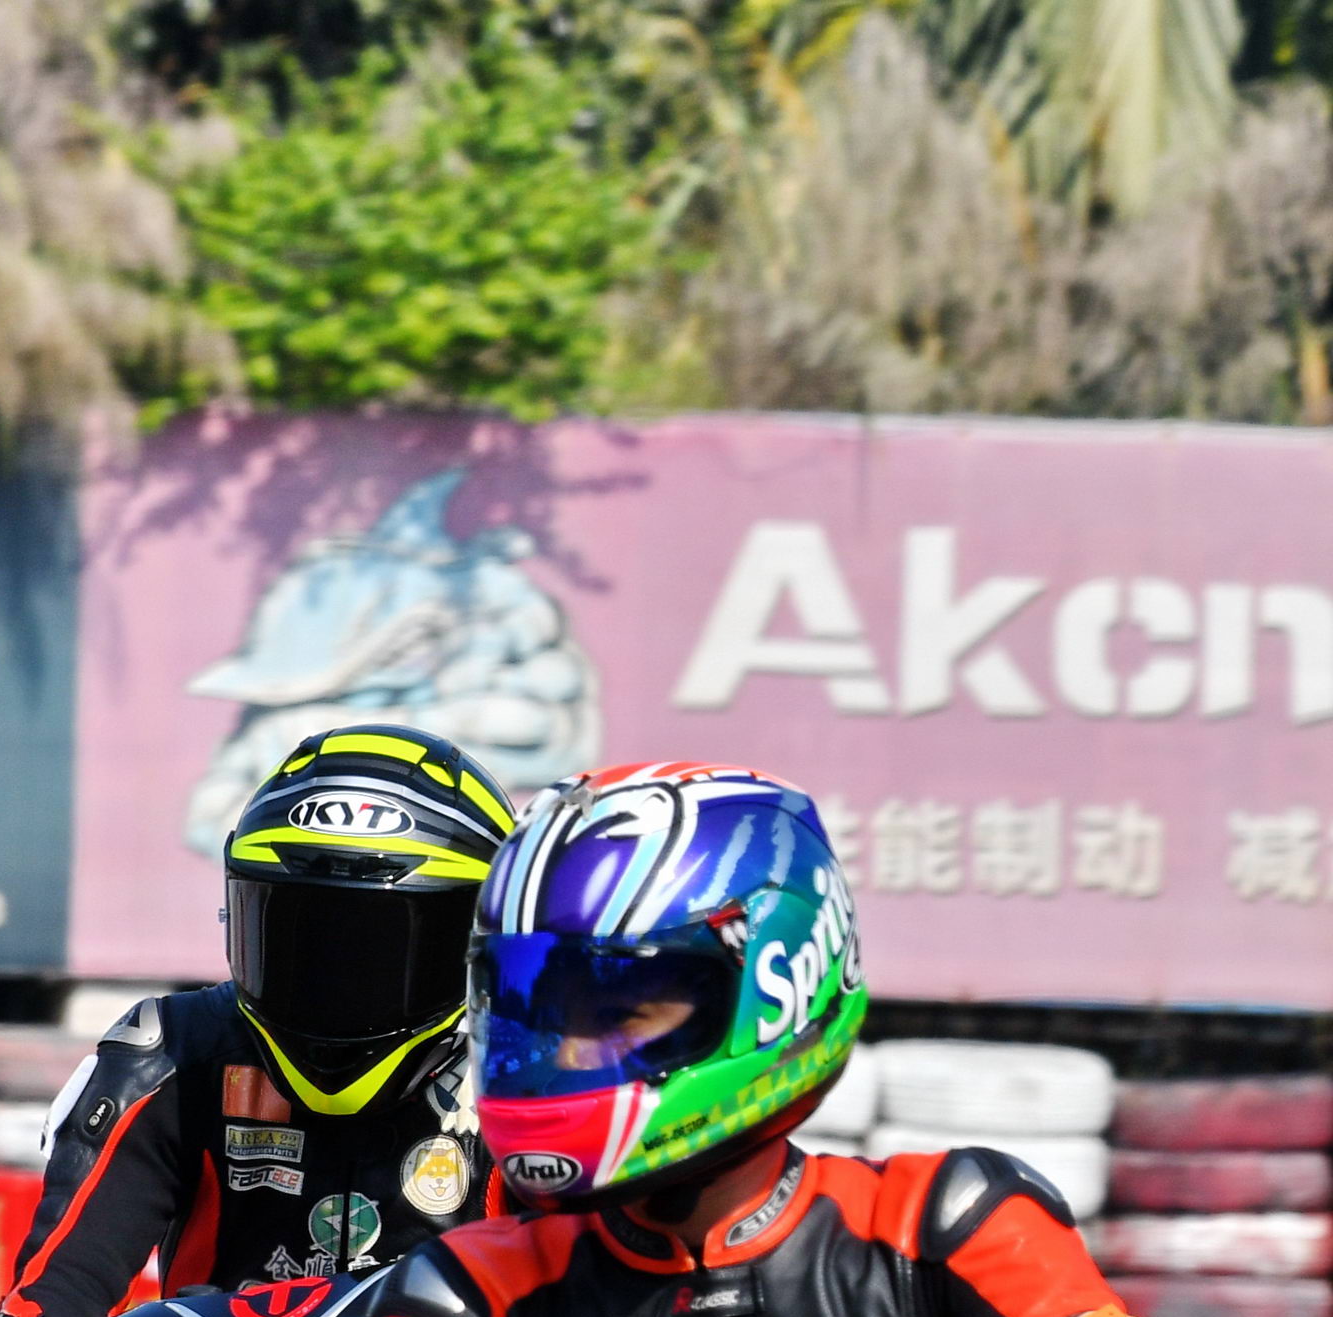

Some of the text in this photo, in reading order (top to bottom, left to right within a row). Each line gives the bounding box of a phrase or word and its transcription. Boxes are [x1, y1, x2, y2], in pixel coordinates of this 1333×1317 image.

[301, 800, 399, 830] KYT
[229, 1129, 276, 1146] AREA
[511, 1155, 567, 1180] Arai
